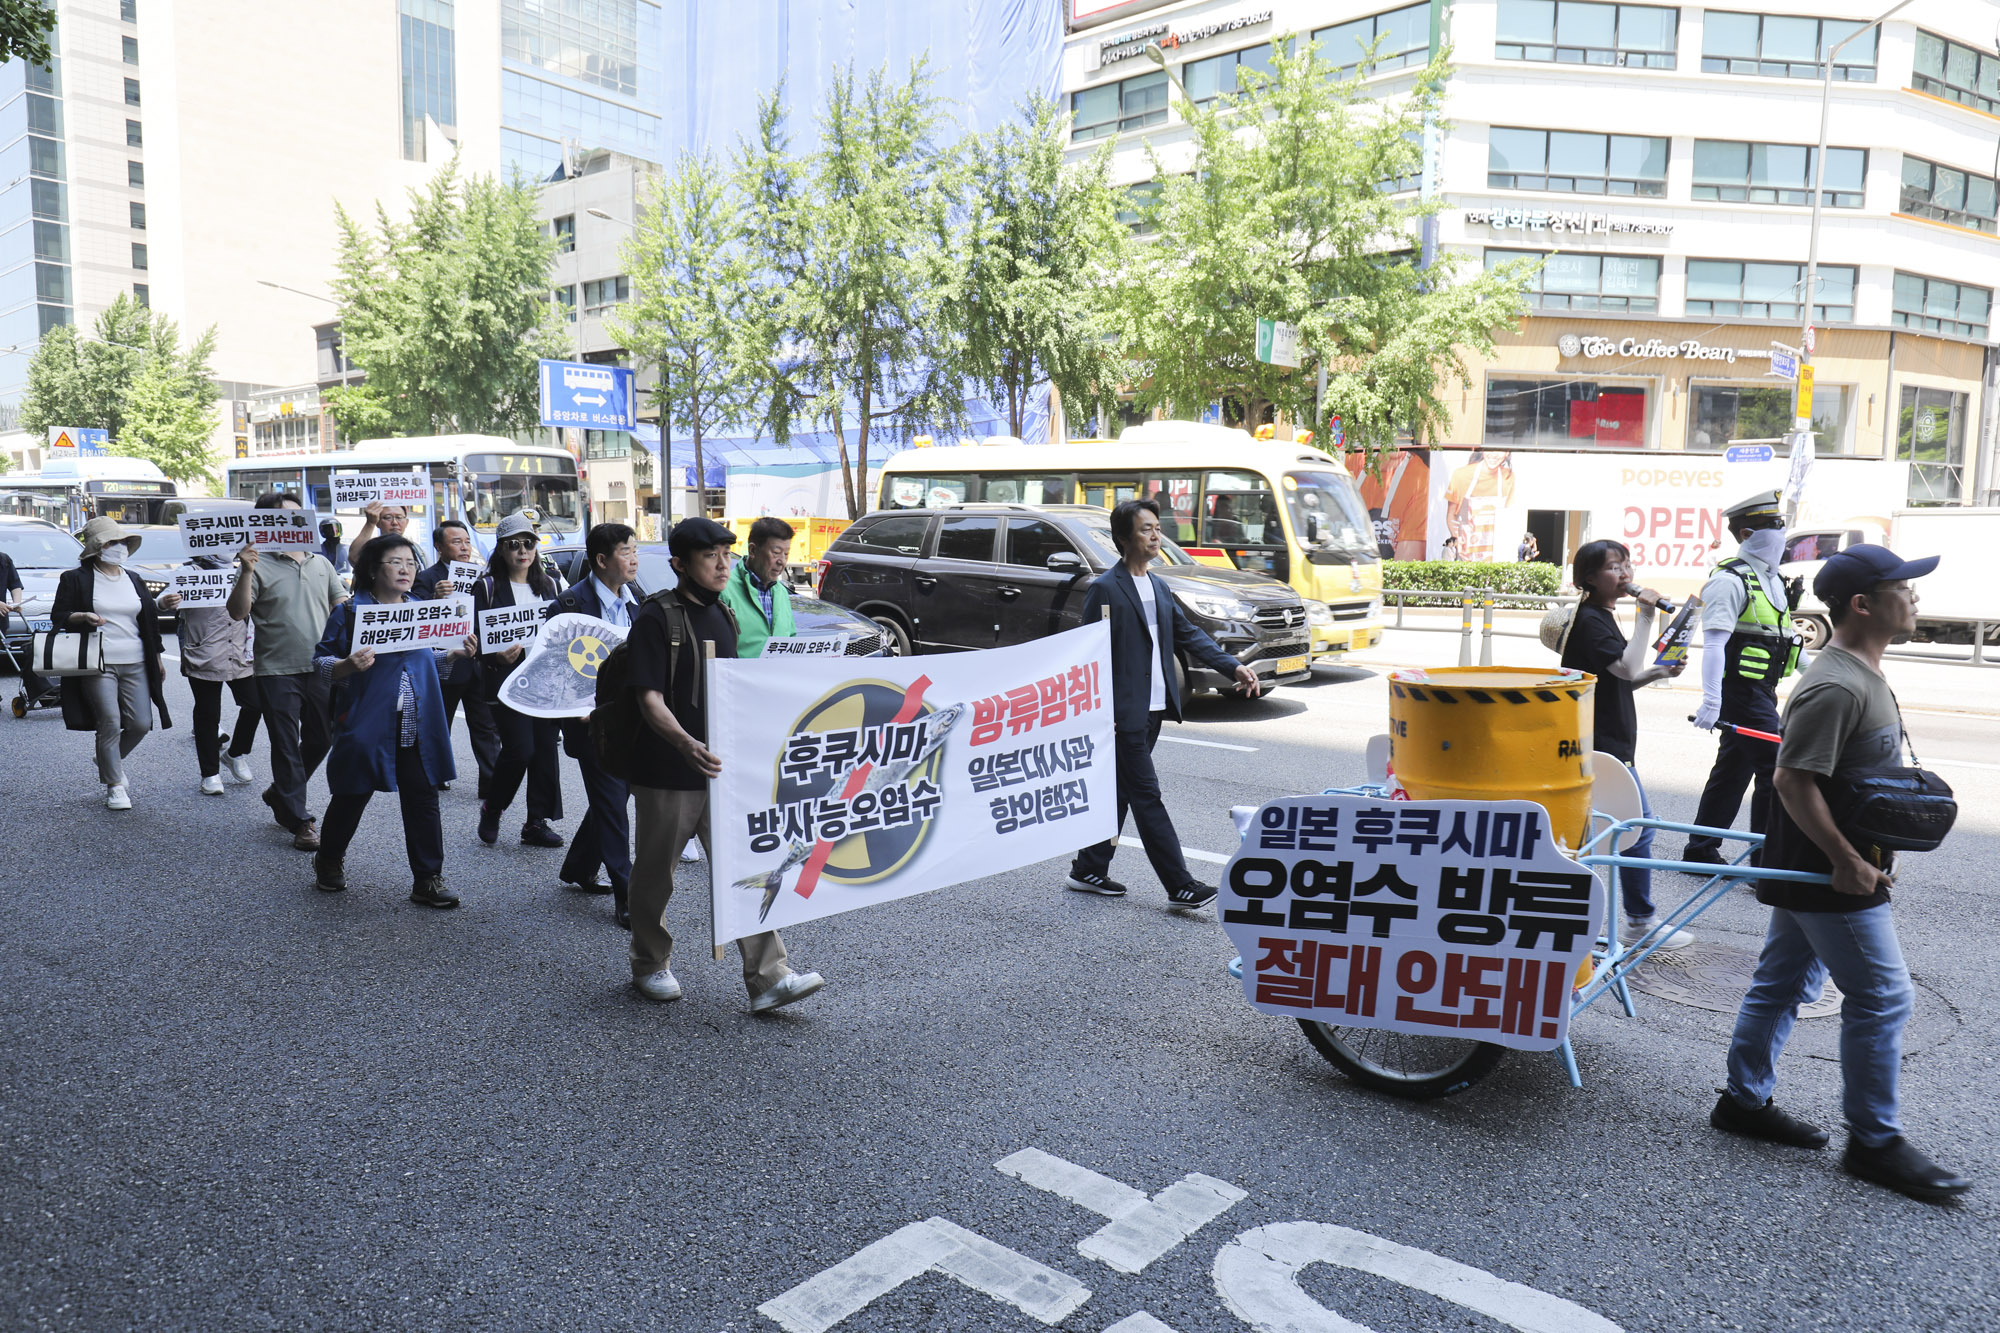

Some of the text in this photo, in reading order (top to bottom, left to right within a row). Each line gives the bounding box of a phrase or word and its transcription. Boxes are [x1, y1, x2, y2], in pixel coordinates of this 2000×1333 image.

[1580, 336, 1736, 364] The Coffee Bean
[552, 409, 626, 426] 중앙차로 버스전용
[503, 456, 542, 473] 741
[102, 482, 118, 493] 720
[334, 477, 409, 489] 후쿠시마 오염수
[336, 489, 427, 503] 해양투기 결사반대!
[185, 514, 288, 531] 후쿠시마 오염수
[818, 525, 842, 534] DHL
[1623, 506, 1723, 540] OPEN
[189, 530, 314, 548] 해양투기 결사반대!
[175, 575, 223, 587] 후쿠시마
[180, 588, 226, 601] 해양투기
[362, 605, 452, 625] 후쿠시마 오염수
[485, 608, 535, 628] 후쿠시마
[360, 620, 470, 645] 해양투기 결사반대!
[487, 625, 538, 645] 해양투기
[767, 641, 831, 654] 후쿠시마 오염수
[969, 661, 1102, 747] 방류멈춰!
[784, 721, 929, 782] 후쿠시마
[967, 734, 1095, 793] 일본대사관
[747, 779, 943, 854] 방사능오염수
[989, 778, 1090, 835] 항의행진
[1260, 806, 1542, 860] 일본 후쿠시마
[1223, 857, 1593, 952] 오염수 방류
[1255, 936, 1566, 1040] 절대 안돼!
